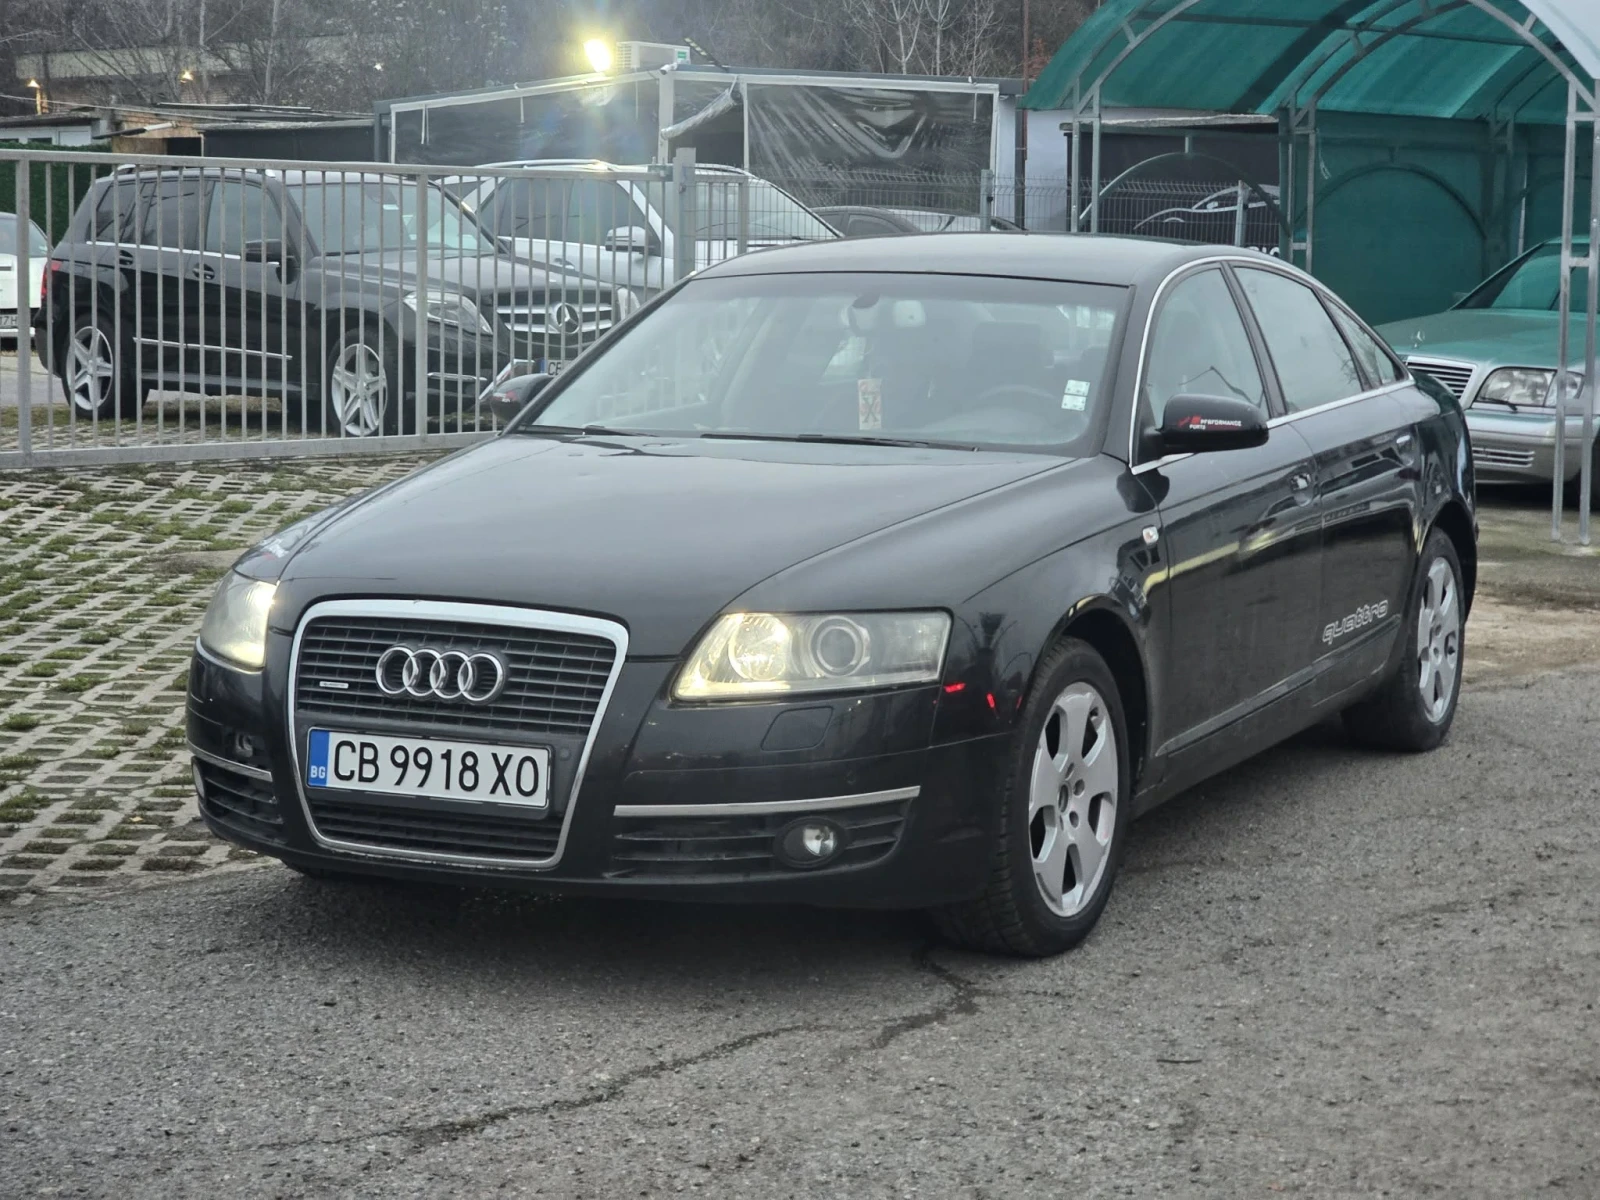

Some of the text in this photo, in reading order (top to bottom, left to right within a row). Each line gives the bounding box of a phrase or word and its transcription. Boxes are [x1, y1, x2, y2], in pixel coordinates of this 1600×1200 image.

[1322, 599, 1388, 645] quattro
[310, 765, 326, 779] BG
[333, 739, 539, 797] CB 9918 XO
